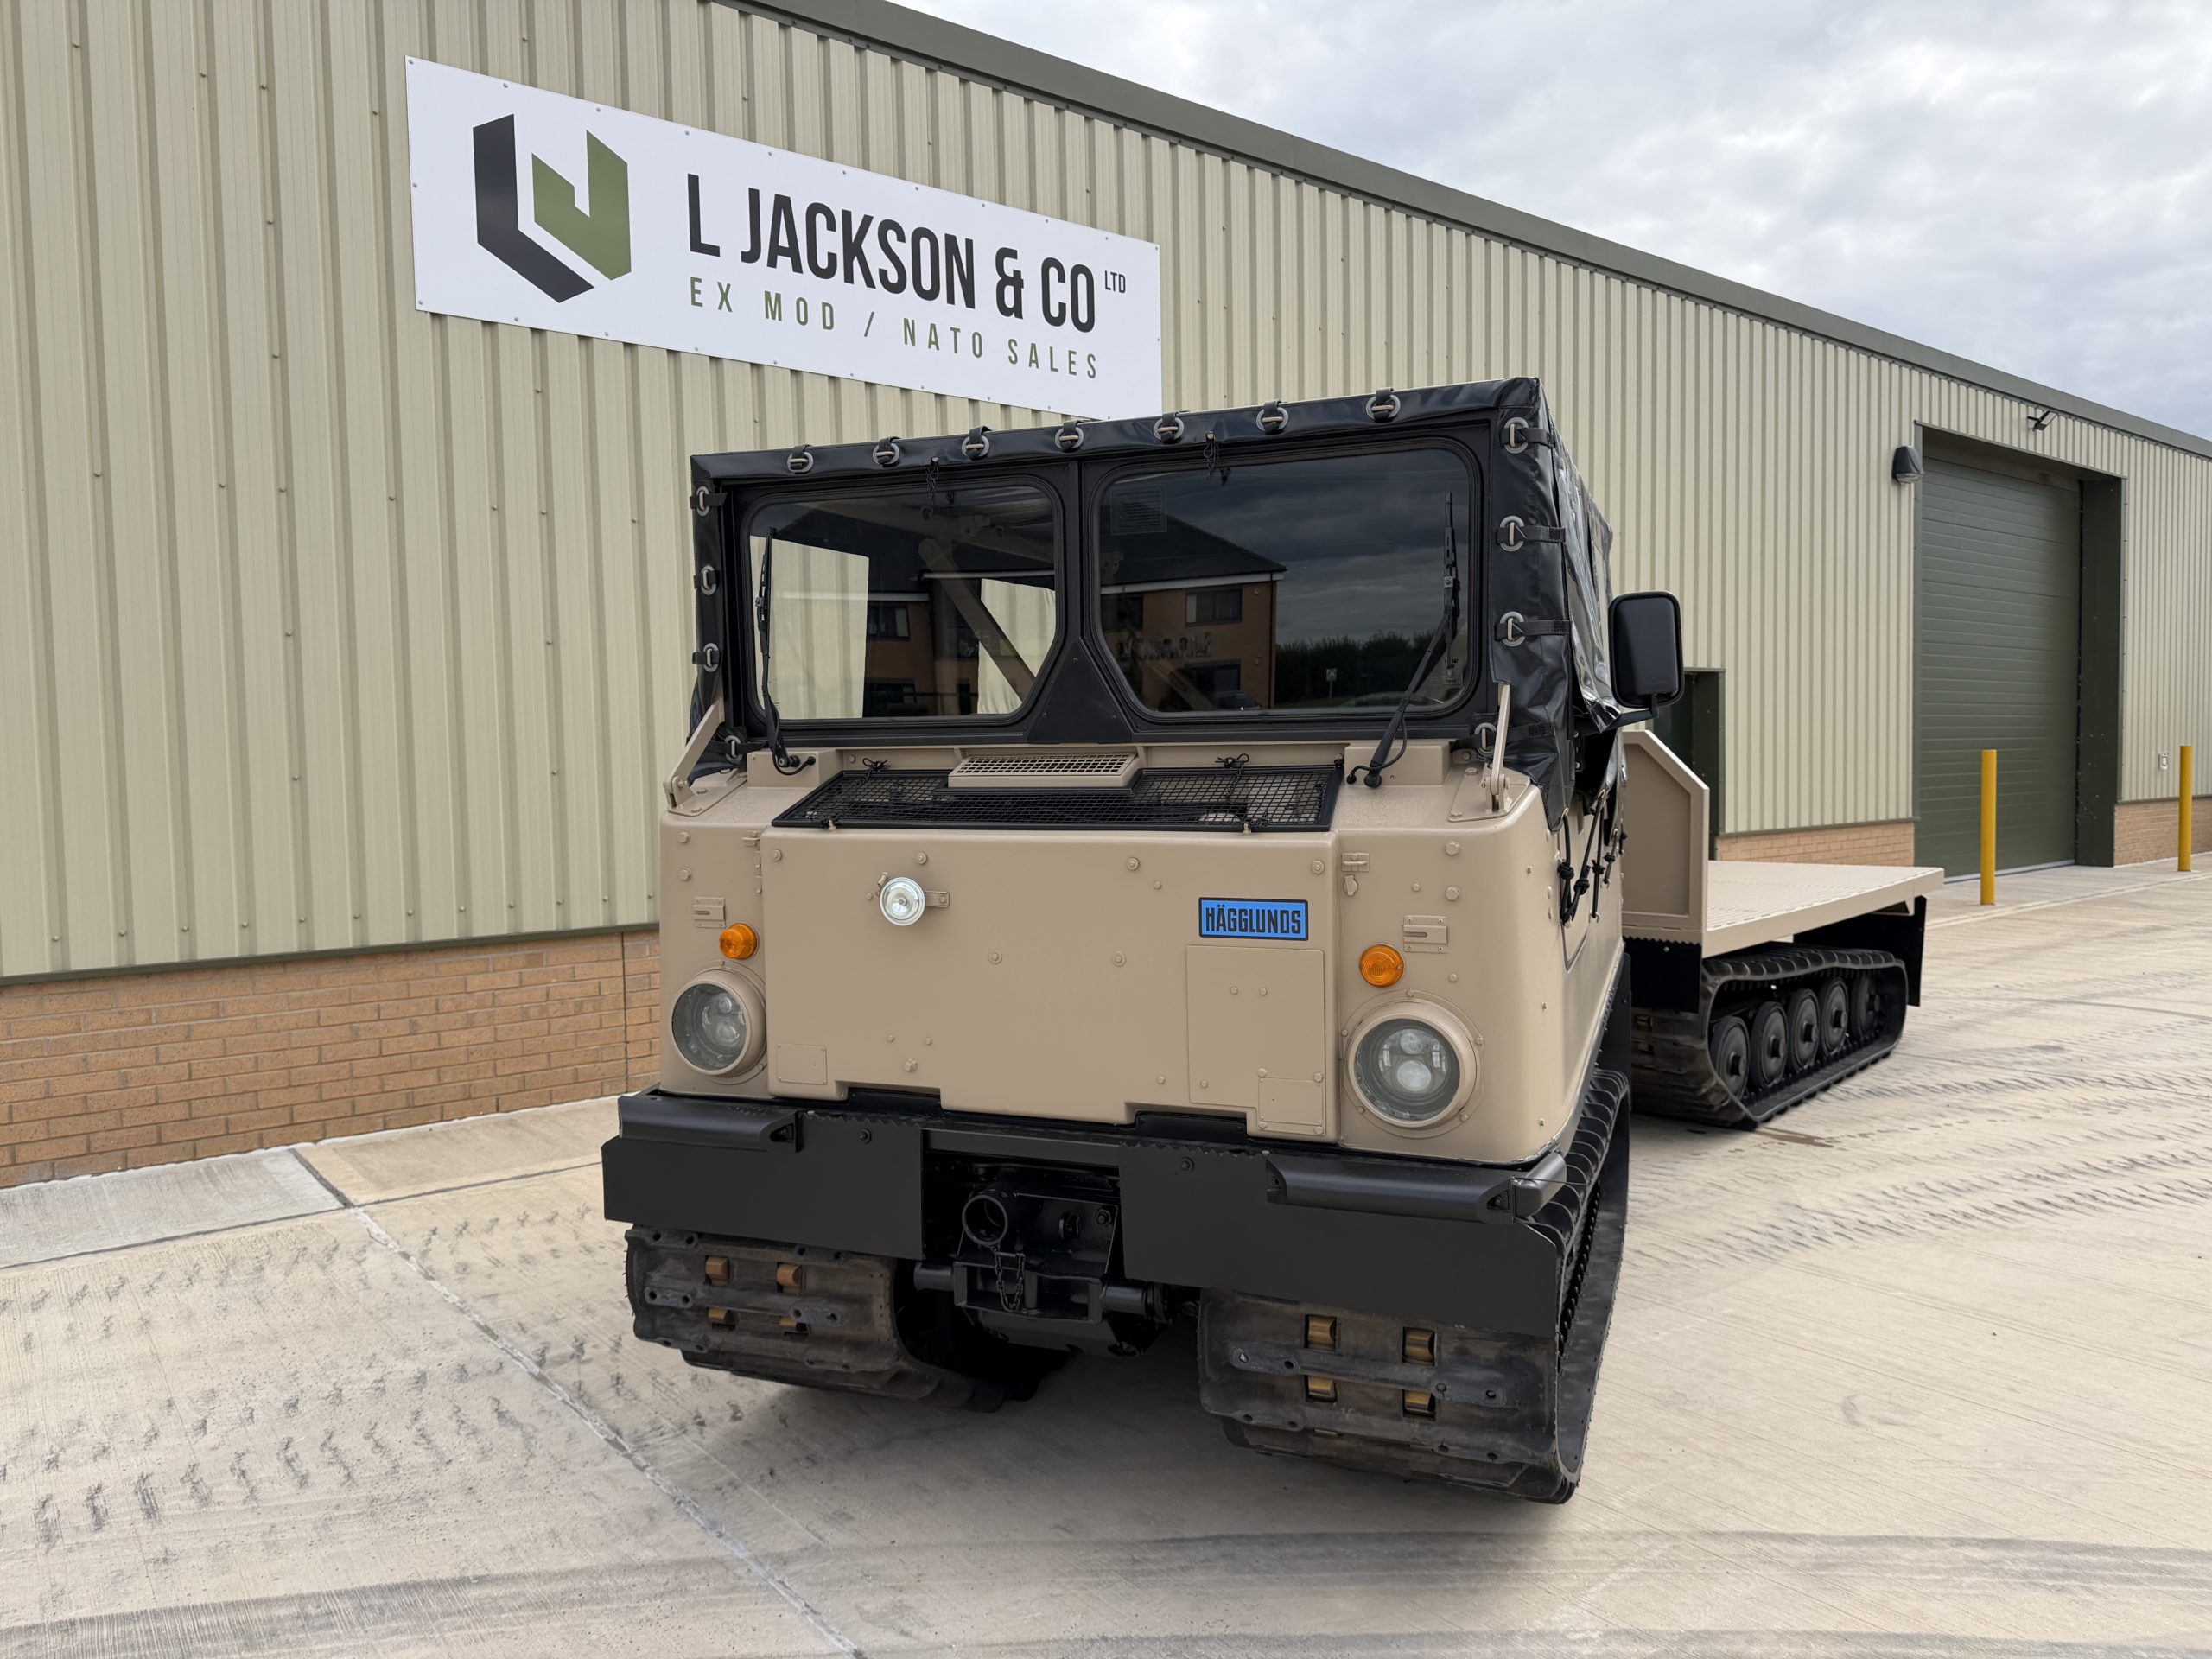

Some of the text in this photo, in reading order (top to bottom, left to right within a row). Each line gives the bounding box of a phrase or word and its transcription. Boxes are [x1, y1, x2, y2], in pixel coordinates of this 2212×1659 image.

[688, 174, 1127, 334] L JACKSON & CO LTD
[690, 276, 1097, 379] EX MOD / NATO SALES
[1205, 904, 1301, 934] HÄGGLUNDS
